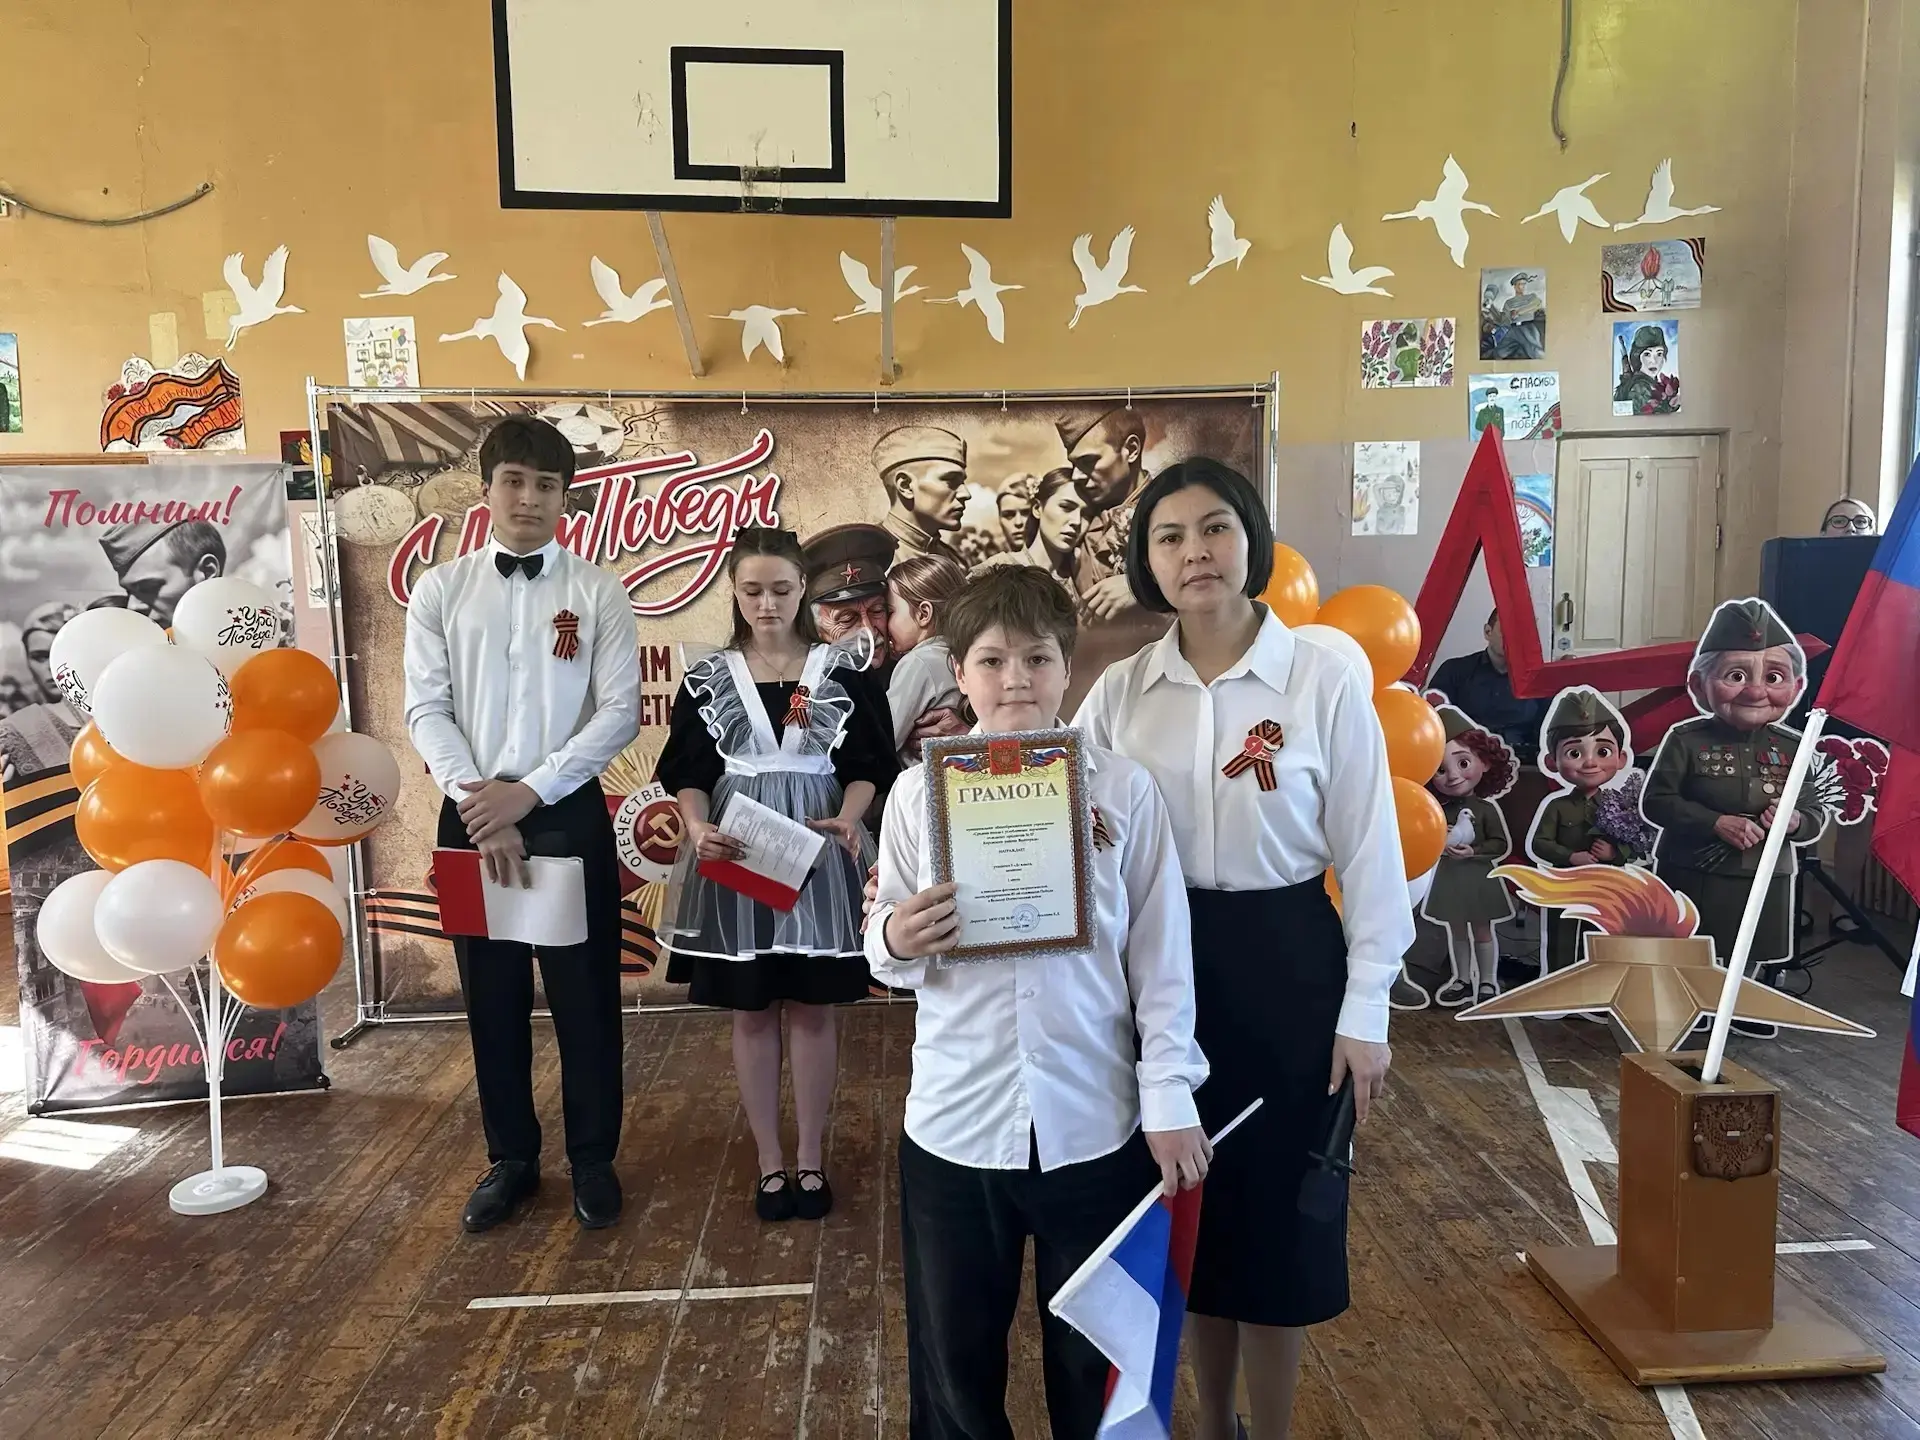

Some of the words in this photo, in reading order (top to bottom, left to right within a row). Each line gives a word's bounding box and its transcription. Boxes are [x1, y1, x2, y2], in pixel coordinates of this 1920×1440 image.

[1510, 376, 1556, 389] СПАСИБО
[1519, 390, 1548, 402] ДЕДУ
[1520, 403, 1540, 419] ЗА
[117, 421, 131, 434] 9
[1511, 420, 1537, 429] ПОБЕ
[44, 485, 243, 528] Помним!
[388, 512, 444, 608] С
[957, 782, 1060, 805] ГРАМОТА
[617, 784, 671, 869] ОТЕЧЕСТВЕ
